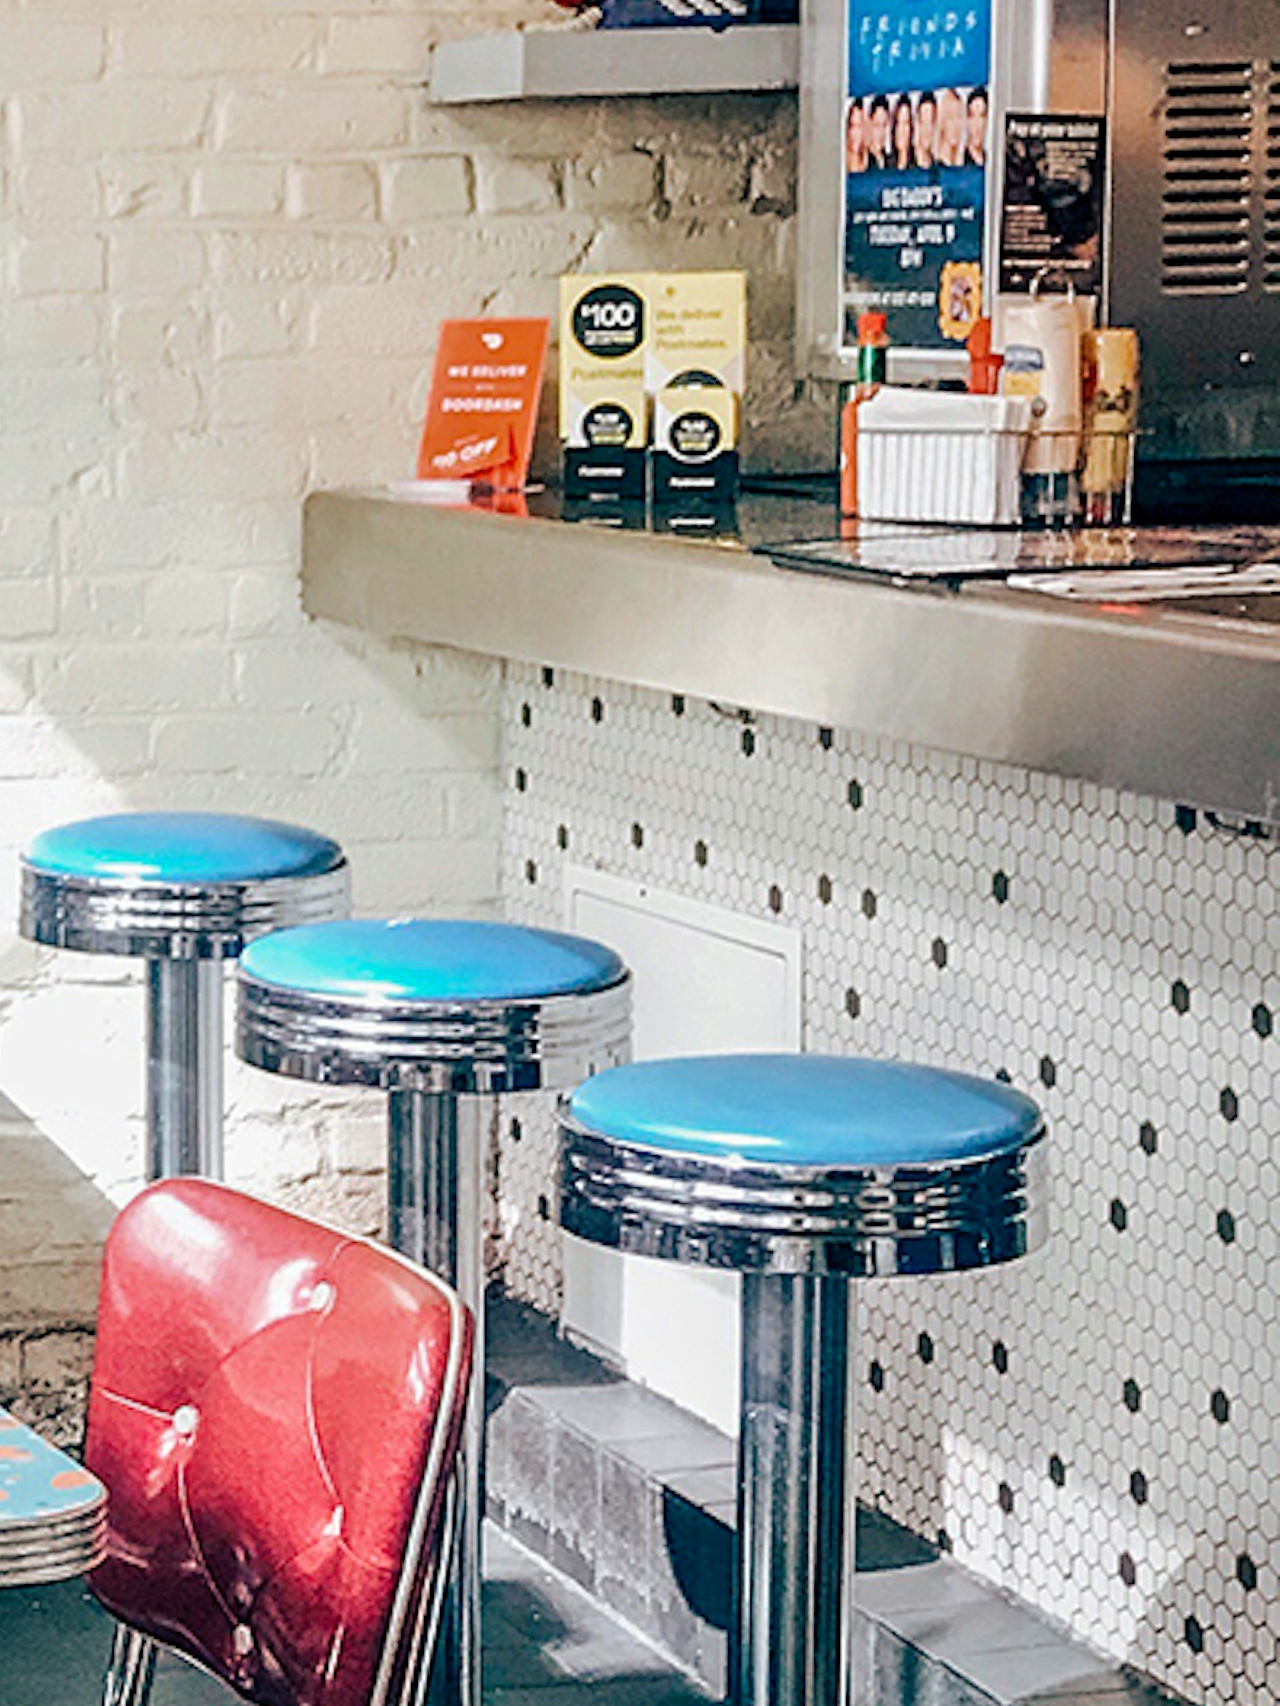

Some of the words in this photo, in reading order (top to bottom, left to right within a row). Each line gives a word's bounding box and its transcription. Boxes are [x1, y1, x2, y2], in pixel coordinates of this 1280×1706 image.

[858, 9, 979, 45] FRIENDS
[870, 39, 966, 73] TRIVIA
[581, 303, 636, 329] $100
[448, 365, 469, 377] WE
[472, 365, 526, 378] DELIVER
[442, 398, 523, 413] DOORDASH
